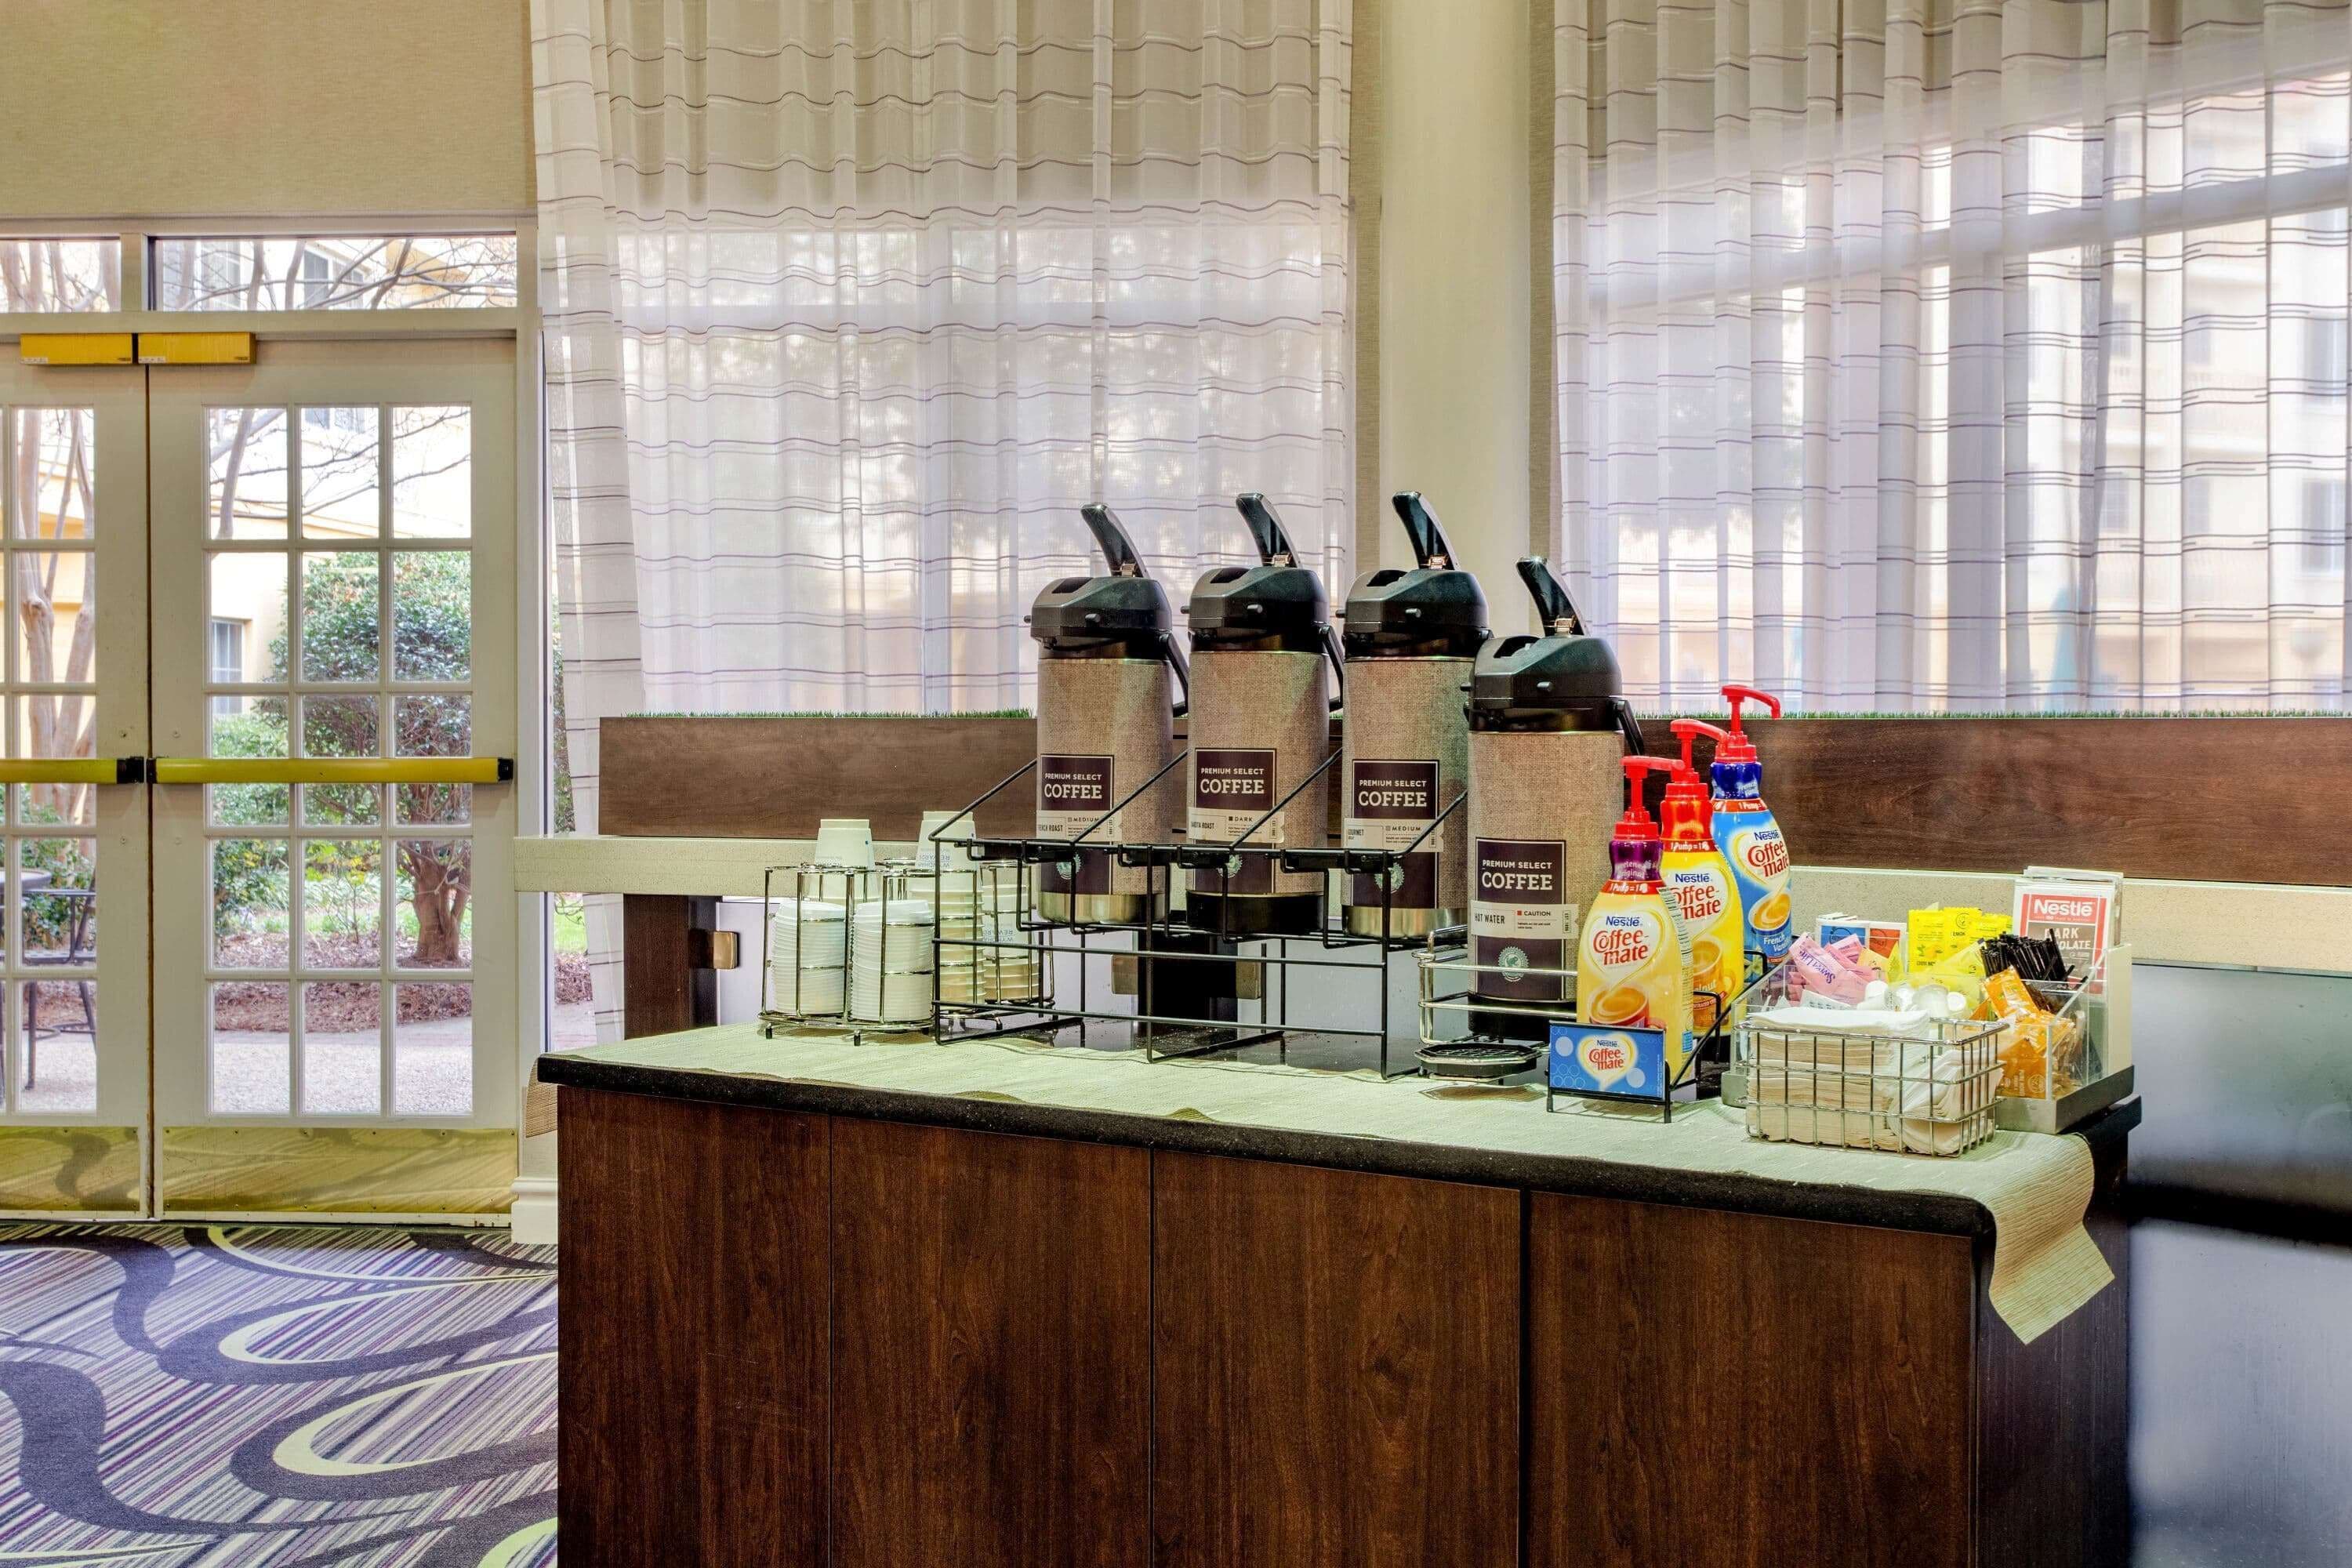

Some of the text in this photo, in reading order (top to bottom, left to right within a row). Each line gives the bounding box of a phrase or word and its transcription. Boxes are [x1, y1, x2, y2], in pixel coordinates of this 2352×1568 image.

[1044, 783, 1102, 799] COFFEE
[1200, 779, 1265, 794] COFFEE
[1358, 791, 1427, 807] COFFEE
[1482, 859, 1515, 868] PREMIUM
[1482, 871, 1553, 891] COFFEE
[1484, 915, 1505, 924] WATER
[1764, 933, 1785, 945] French
[1603, 944, 1649, 966] mate
[1597, 1058, 1624, 1070] mate
